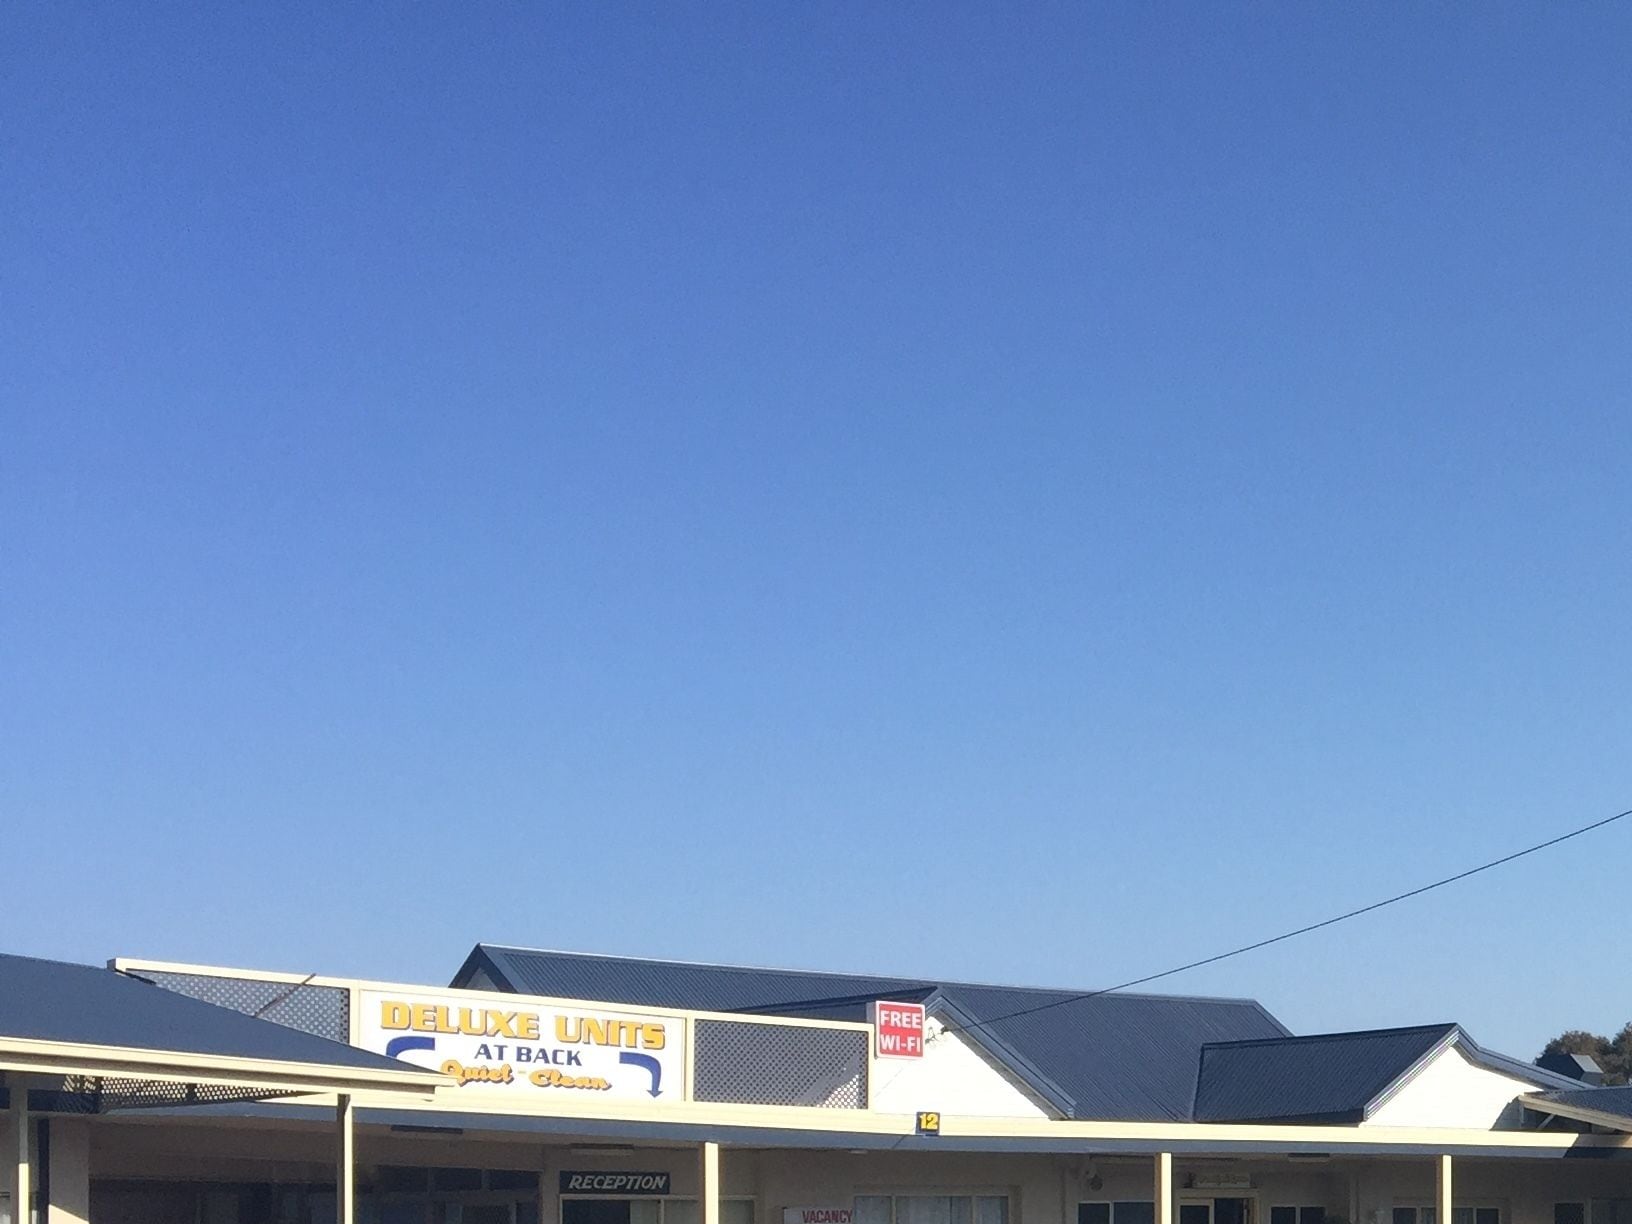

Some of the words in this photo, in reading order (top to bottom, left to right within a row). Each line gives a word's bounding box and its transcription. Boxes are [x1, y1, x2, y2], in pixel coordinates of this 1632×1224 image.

[380, 1000, 540, 1040] DELUXE
[554, 1015, 666, 1050] UNITS
[879, 1010, 922, 1029] FREE
[880, 1034, 921, 1053] WI-FI
[475, 1043, 508, 1062] AT
[516, 1046, 583, 1066] BACK
[440, 1059, 515, 1087] Quiet
[529, 1068, 612, 1091] Clean
[919, 1112, 938, 1130] 12
[568, 1174, 667, 1190] RECEPTION
[802, 1208, 853, 1224] VACANCY
